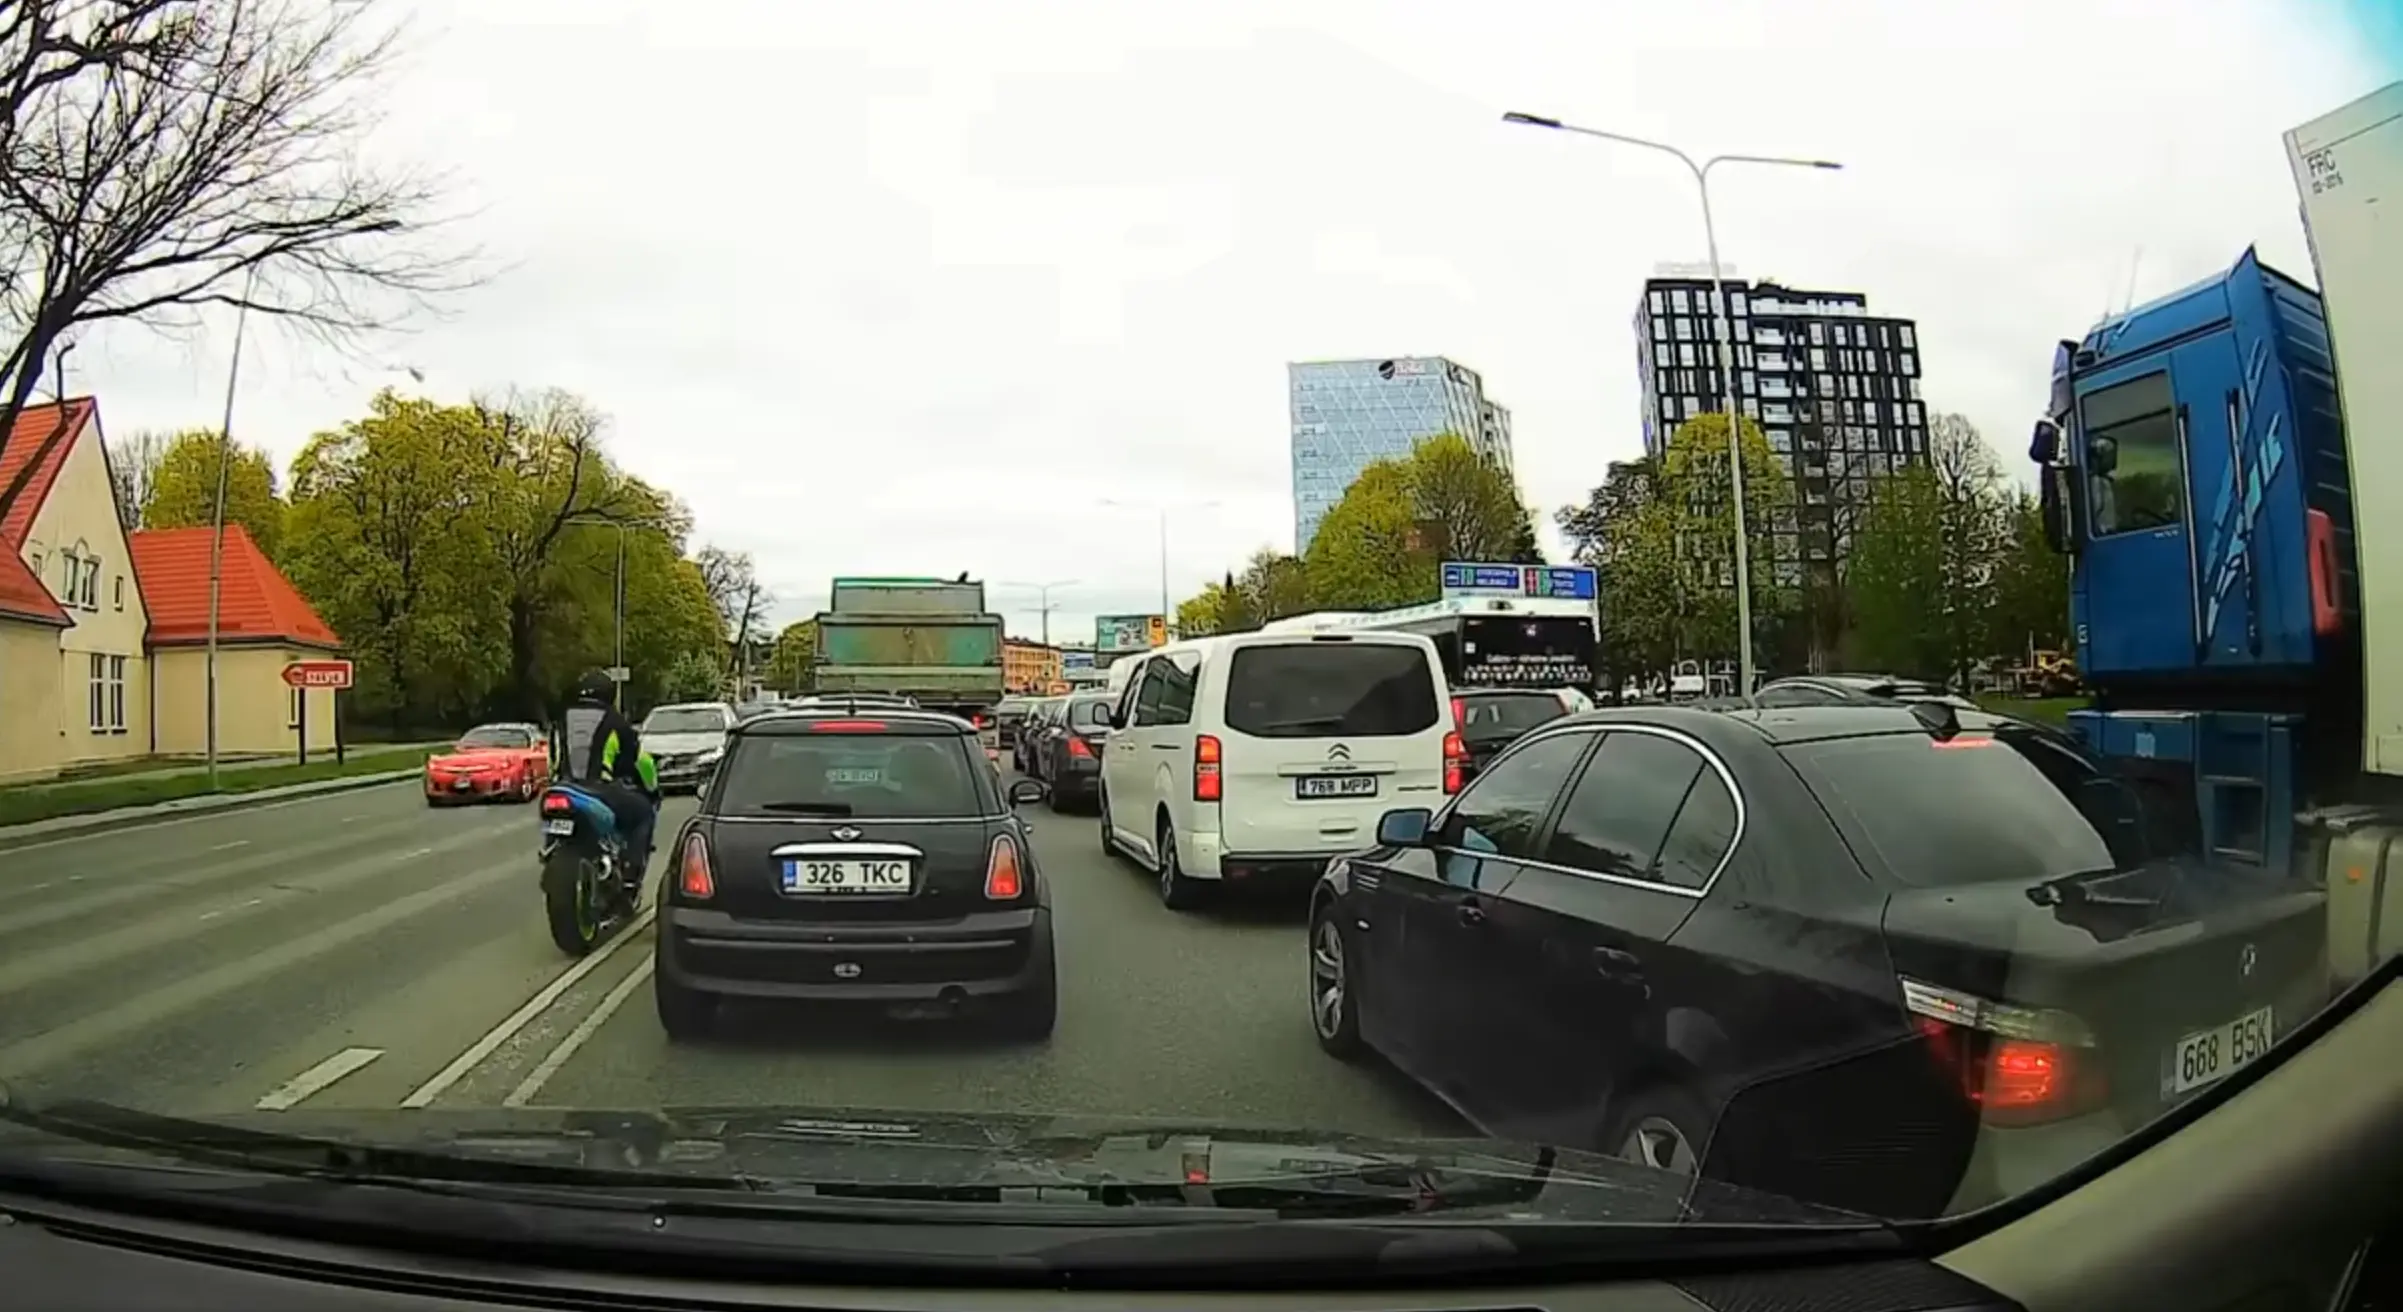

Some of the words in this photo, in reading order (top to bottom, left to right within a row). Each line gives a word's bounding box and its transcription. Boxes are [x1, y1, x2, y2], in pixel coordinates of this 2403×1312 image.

[2308, 149, 2336, 178] FRC
[806, 863, 845, 884] 326
[859, 863, 904, 884] TKC
[2182, 1034, 2219, 1082] 668
[2231, 1009, 2268, 1065] BSK
